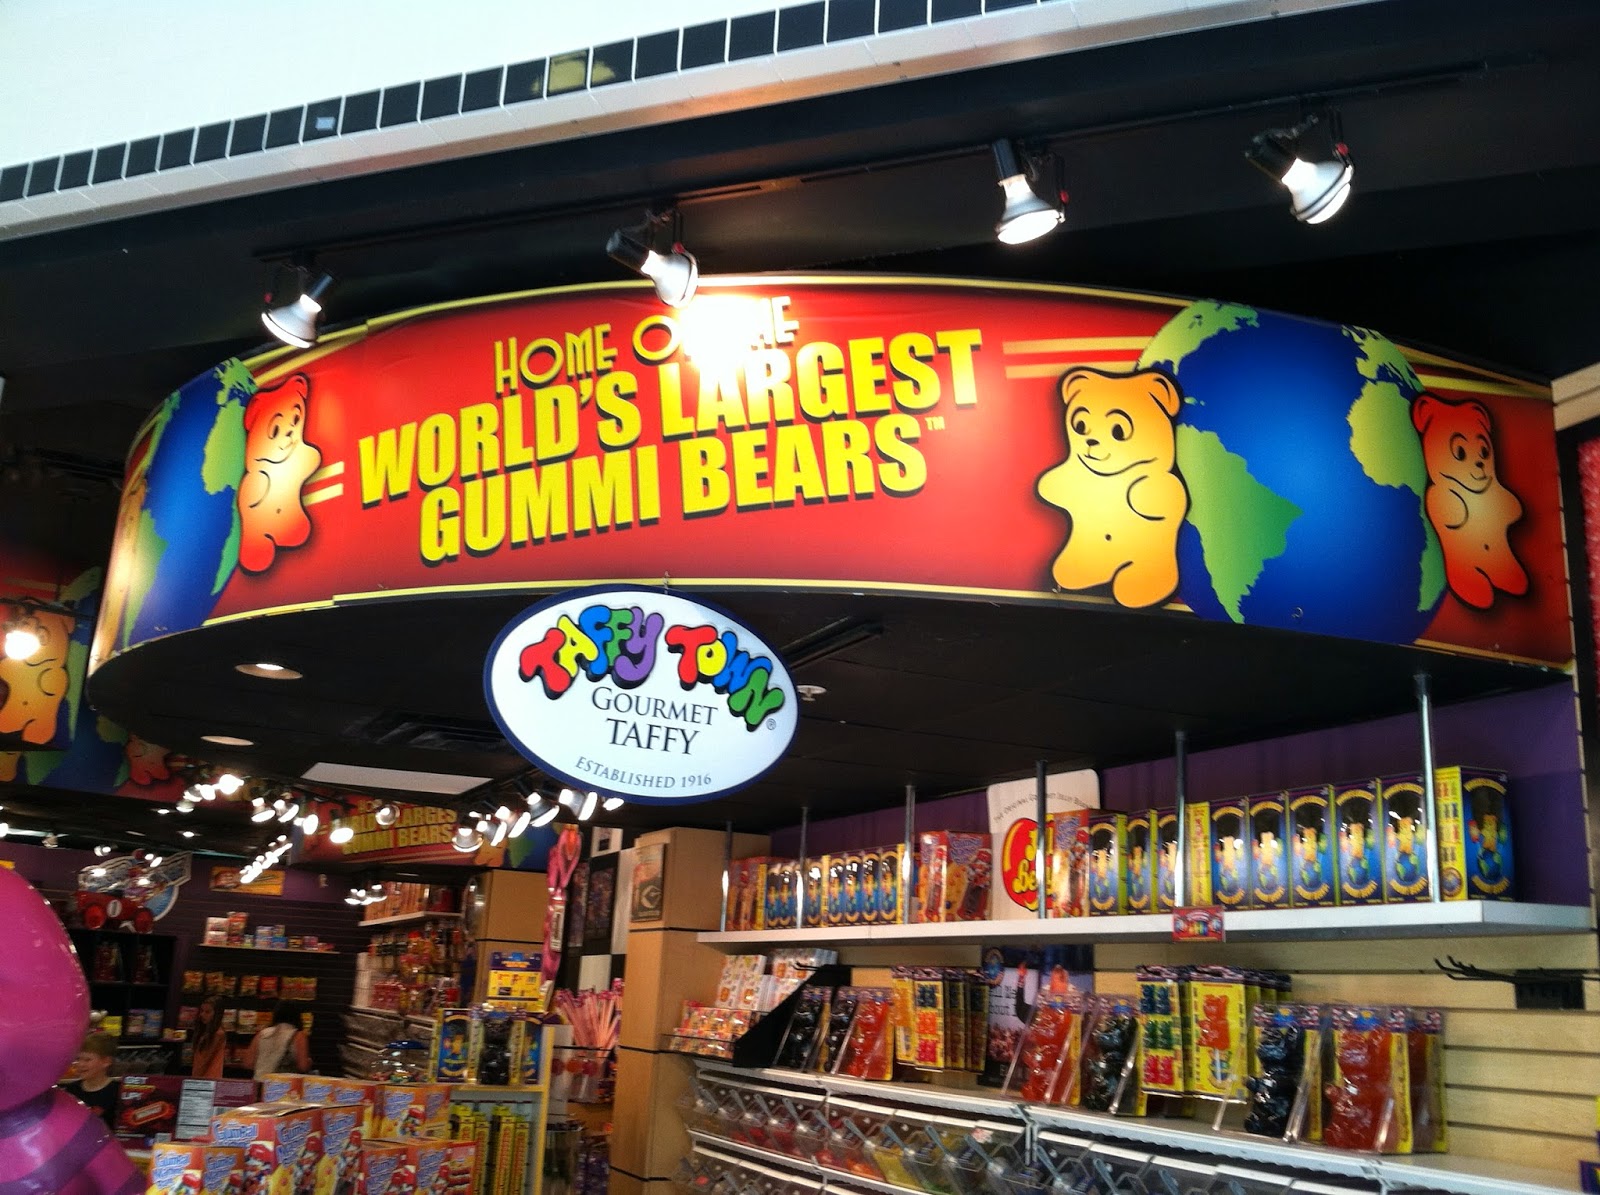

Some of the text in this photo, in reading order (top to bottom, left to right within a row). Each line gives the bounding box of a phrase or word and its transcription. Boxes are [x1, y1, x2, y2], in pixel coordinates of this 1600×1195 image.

[494, 323, 618, 395] HOME
[358, 328, 983, 509] WORLD'S LARGEST
[420, 444, 662, 566] GUMMI
[680, 413, 930, 520] BEARS
[519, 604, 664, 700] TAFFY
[665, 624, 785, 732] TOWN
[591, 686, 719, 726] GOURMET
[606, 718, 700, 755] TAFFY
[575, 756, 712, 789] ESTABLISHED 1916
